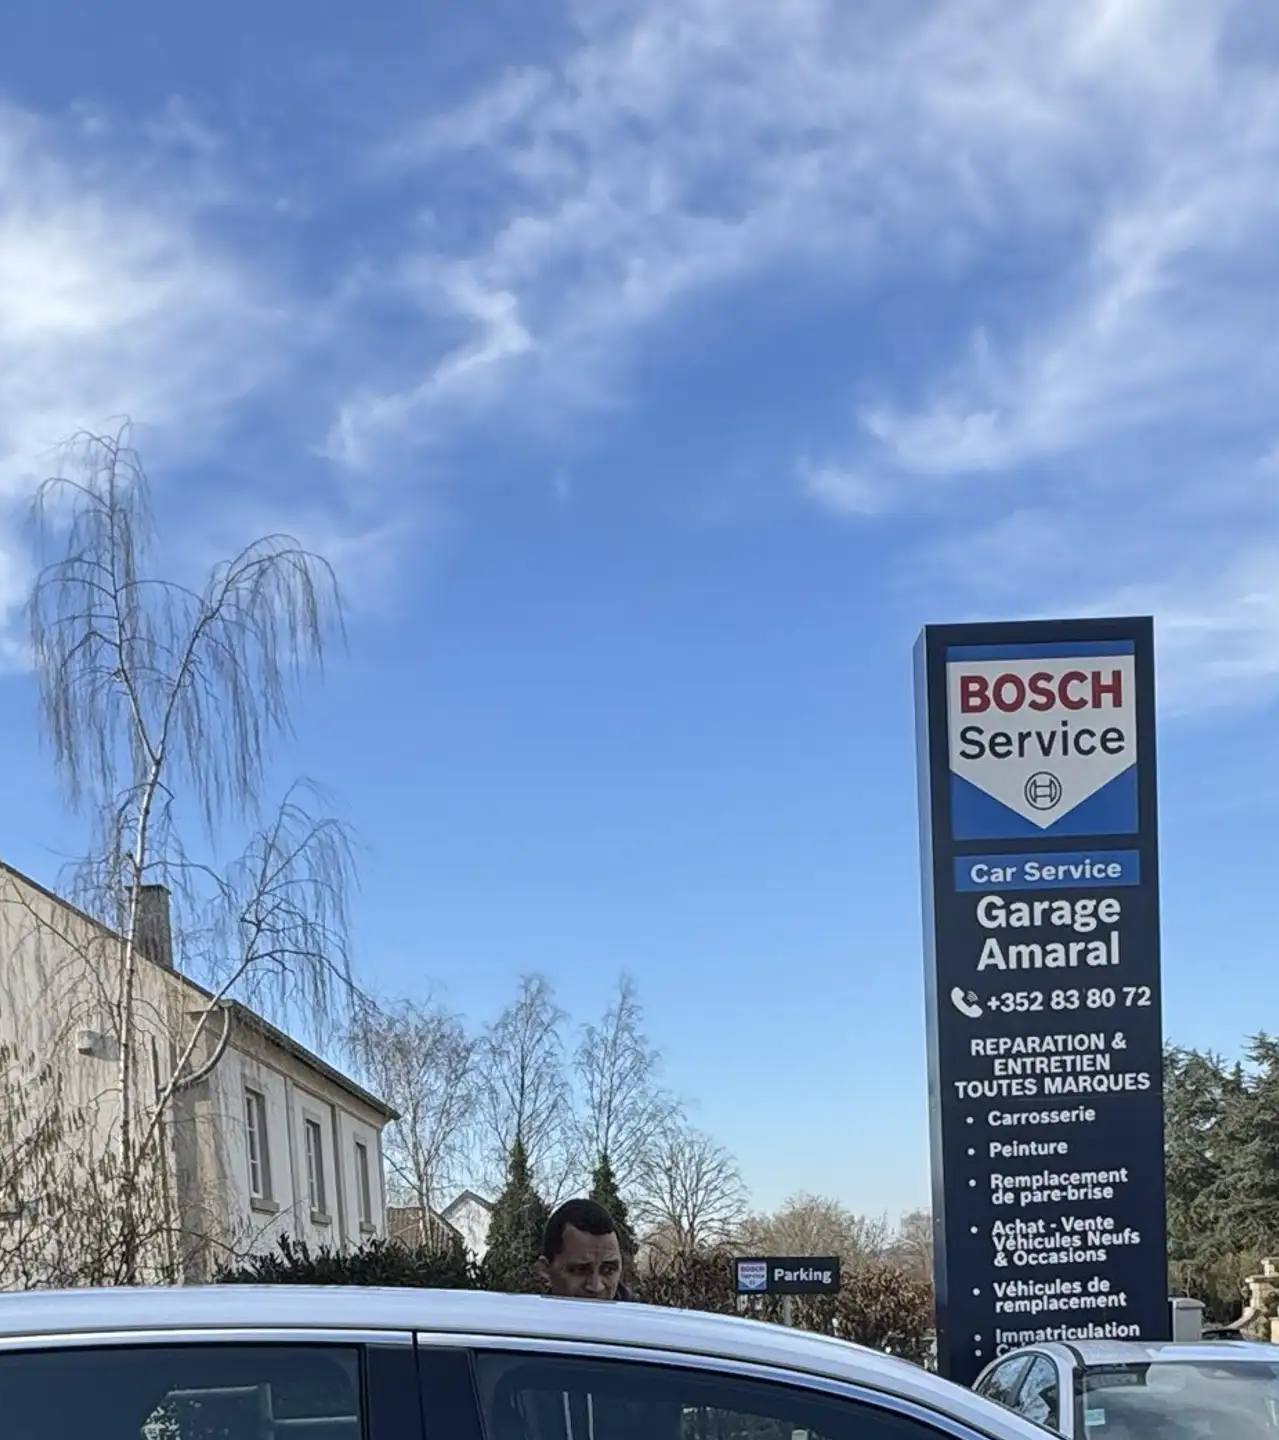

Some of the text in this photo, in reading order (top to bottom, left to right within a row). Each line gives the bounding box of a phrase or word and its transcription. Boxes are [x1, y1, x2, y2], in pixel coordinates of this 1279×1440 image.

[959, 669, 1123, 714] BOSCH
[958, 720, 1126, 760] Service
[970, 859, 1122, 884] Car Service
[976, 895, 1122, 932] Garage
[976, 931, 1121, 972] Amaral
[987, 986, 1152, 1012] +352 83 80 72
[971, 1032, 1127, 1056] REPARATION &
[994, 1053, 1111, 1076] ENTRETIEN
[954, 1072, 1151, 1099] TOUTES MARQUES
[988, 1106, 1096, 1126] Carrosserie
[989, 1140, 1068, 1158] Peinture
[990, 1167, 1129, 1190] Remplacement
[991, 1185, 1114, 1207] de pare-brise
[991, 1218, 1045, 1236] Achat
[1060, 1216, 1115, 1232] Vente
[992, 1228, 1141, 1251] Véhicules Neufs
[993, 1248, 1108, 1267] & Occasions
[773, 1268, 832, 1284] Parking
[993, 1276, 1111, 1298] Véhicules de
[995, 1291, 1128, 1315] remplacement
[995, 1322, 1141, 1343] Immatriculation
